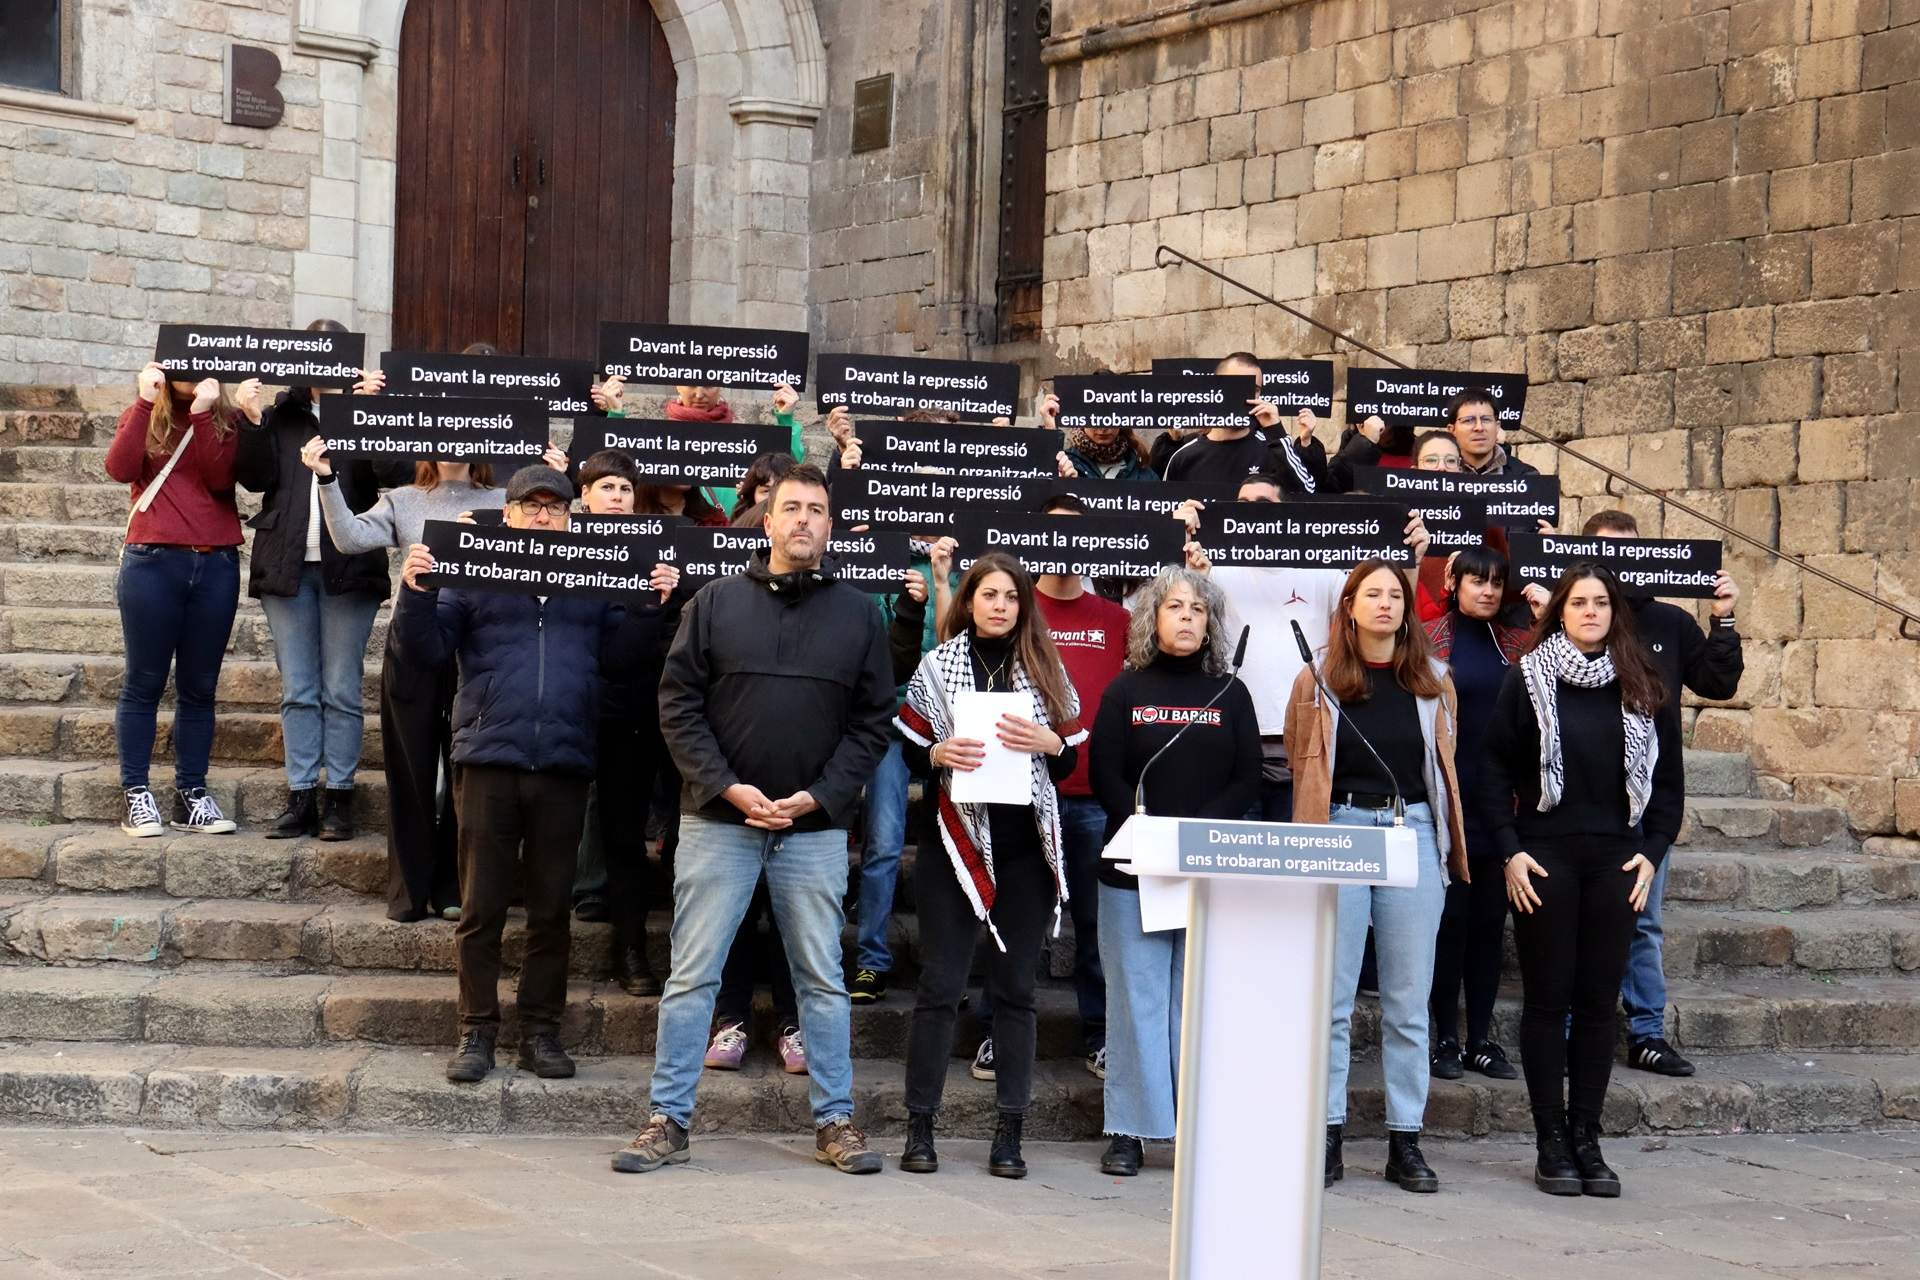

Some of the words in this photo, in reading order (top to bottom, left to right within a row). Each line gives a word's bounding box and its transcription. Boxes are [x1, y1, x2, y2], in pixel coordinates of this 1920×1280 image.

[188, 334, 242, 348] Davant
[246, 335, 258, 348] la
[263, 338, 332, 352] repressió
[630, 338, 686, 354] Davant
[690, 341, 702, 355] la
[708, 345, 777, 359] repressió
[162, 357, 188, 371] ens
[192, 357, 256, 371] trobaran
[260, 360, 359, 378] organitzades
[412, 367, 468, 383] Davant
[473, 370, 485, 384] la
[490, 373, 560, 387] repressió
[605, 364, 631, 377] ens
[636, 363, 702, 379] trobaran
[706, 367, 801, 386] organitzades
[846, 368, 899, 384] Davant
[903, 371, 915, 385] la
[920, 376, 987, 389] repressió
[1263, 371, 1310, 385] pressió
[1377, 380, 1424, 394] Davant
[1428, 382, 1439, 395] la
[822, 393, 846, 403] ens
[851, 391, 914, 408] trobaran
[918, 397, 1012, 415] organitzades
[1084, 390, 1137, 403] Davant
[1141, 389, 1153, 402] la
[1158, 390, 1223, 405] repressió
[1355, 404, 1378, 413] ens
[1382, 403, 1438, 416] trobaran
[354, 410, 414, 426] Davant
[419, 412, 432, 427] la
[438, 414, 513, 430] repressió
[1061, 416, 1086, 426] ens
[1090, 413, 1153, 426] trobaran
[1157, 413, 1251, 429] organitzades
[327, 438, 356, 451] ens
[360, 437, 432, 452] trobaran
[437, 439, 542, 456] organitzades
[605, 433, 662, 449] Davant
[667, 436, 680, 450] la
[685, 439, 757, 454] repressió
[887, 436, 940, 452] Davant
[944, 439, 956, 453] la
[961, 443, 1027, 457] repressió
[636, 458, 680, 475] baran
[683, 461, 748, 481] organitz
[868, 480, 927, 497] Davant
[932, 482, 945, 497] la
[950, 485, 1021, 501] repressió
[1387, 474, 1438, 490] Davant
[1443, 478, 1454, 491] la
[1459, 480, 1527, 495] repressió
[1128, 496, 1140, 510] la
[1486, 501, 1555, 516] anitzades
[842, 509, 869, 520] ens
[874, 507, 944, 523] trobaran
[568, 517, 582, 534] la
[586, 519, 663, 536] repressió
[1224, 519, 1282, 534] Davant
[1287, 519, 1300, 534] la
[1306, 520, 1379, 537] repressió
[460, 532, 525, 553] Davant
[530, 539, 544, 555] la
[550, 545, 629, 561] repressió
[826, 537, 876, 553] ressió
[988, 529, 1048, 546] Davant
[1053, 531, 1066, 546] la
[1072, 534, 1149, 551] repressió
[1428, 529, 1482, 546] nitzades
[1202, 547, 1227, 561] ens
[1231, 545, 1300, 560] trobaran
[1305, 545, 1409, 565] organitzades
[1543, 539, 1598, 555] Davant
[1602, 541, 1615, 556] la
[1620, 544, 1691, 560] repressió
[430, 558, 460, 576] ens
[465, 562, 541, 582] trobaran
[546, 568, 654, 590] organitzades
[686, 563, 715, 575] ens
[1020, 556, 1067, 574] baran
[1071, 559, 1167, 579] organitzad
[1520, 566, 1546, 577] ens
[1619, 568, 1717, 587] organitzades
[1172, 710, 1221, 723] BARRIS
[1209, 830, 1263, 845] Davant
[1268, 832, 1279, 845] la
[1284, 835, 1352, 849] repressió
[1186, 855, 1212, 865] ens
[1216, 854, 1280, 868] trobaran
[1285, 858, 1380, 872] organitzades
